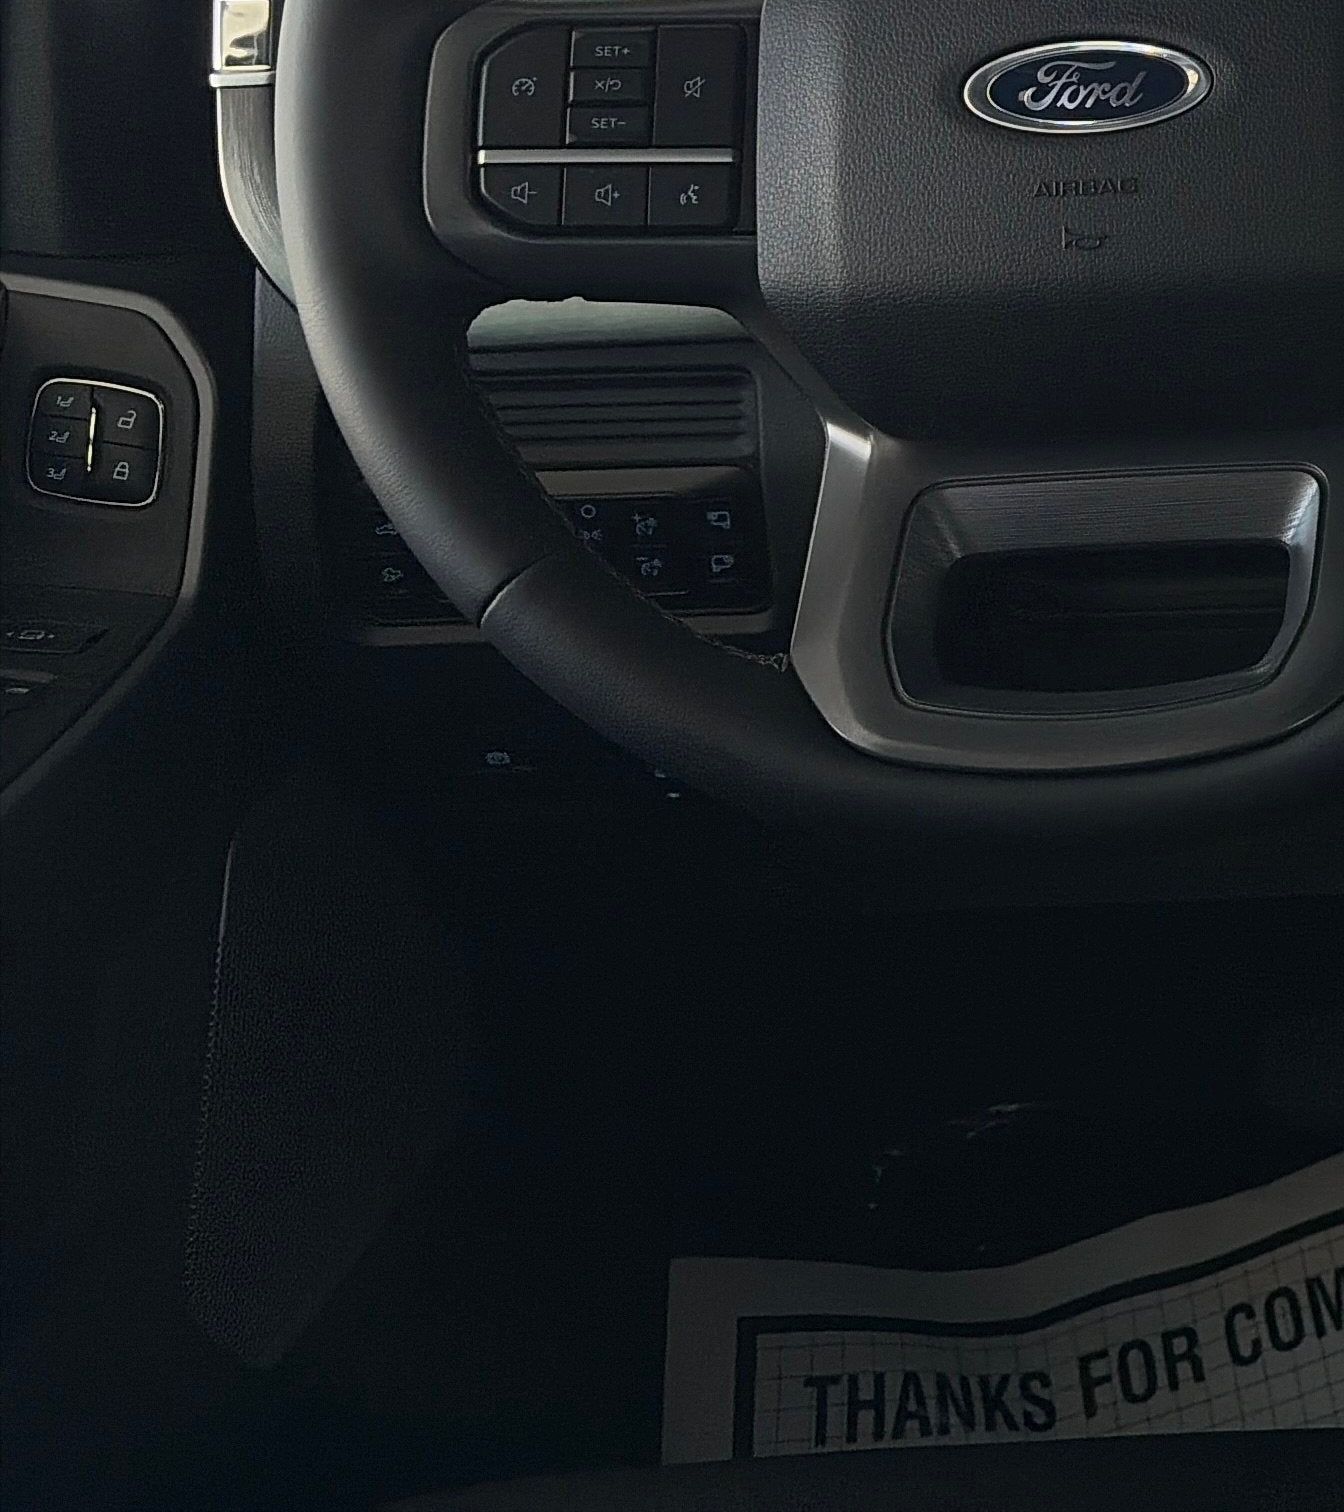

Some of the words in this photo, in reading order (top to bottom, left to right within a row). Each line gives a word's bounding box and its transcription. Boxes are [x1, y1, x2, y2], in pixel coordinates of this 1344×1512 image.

[1018, 60, 1148, 111] Ford
[1032, 178, 1139, 198] AIRBAG
[803, 1370, 1058, 1449] THANKS
[1077, 1326, 1206, 1419] FOR
